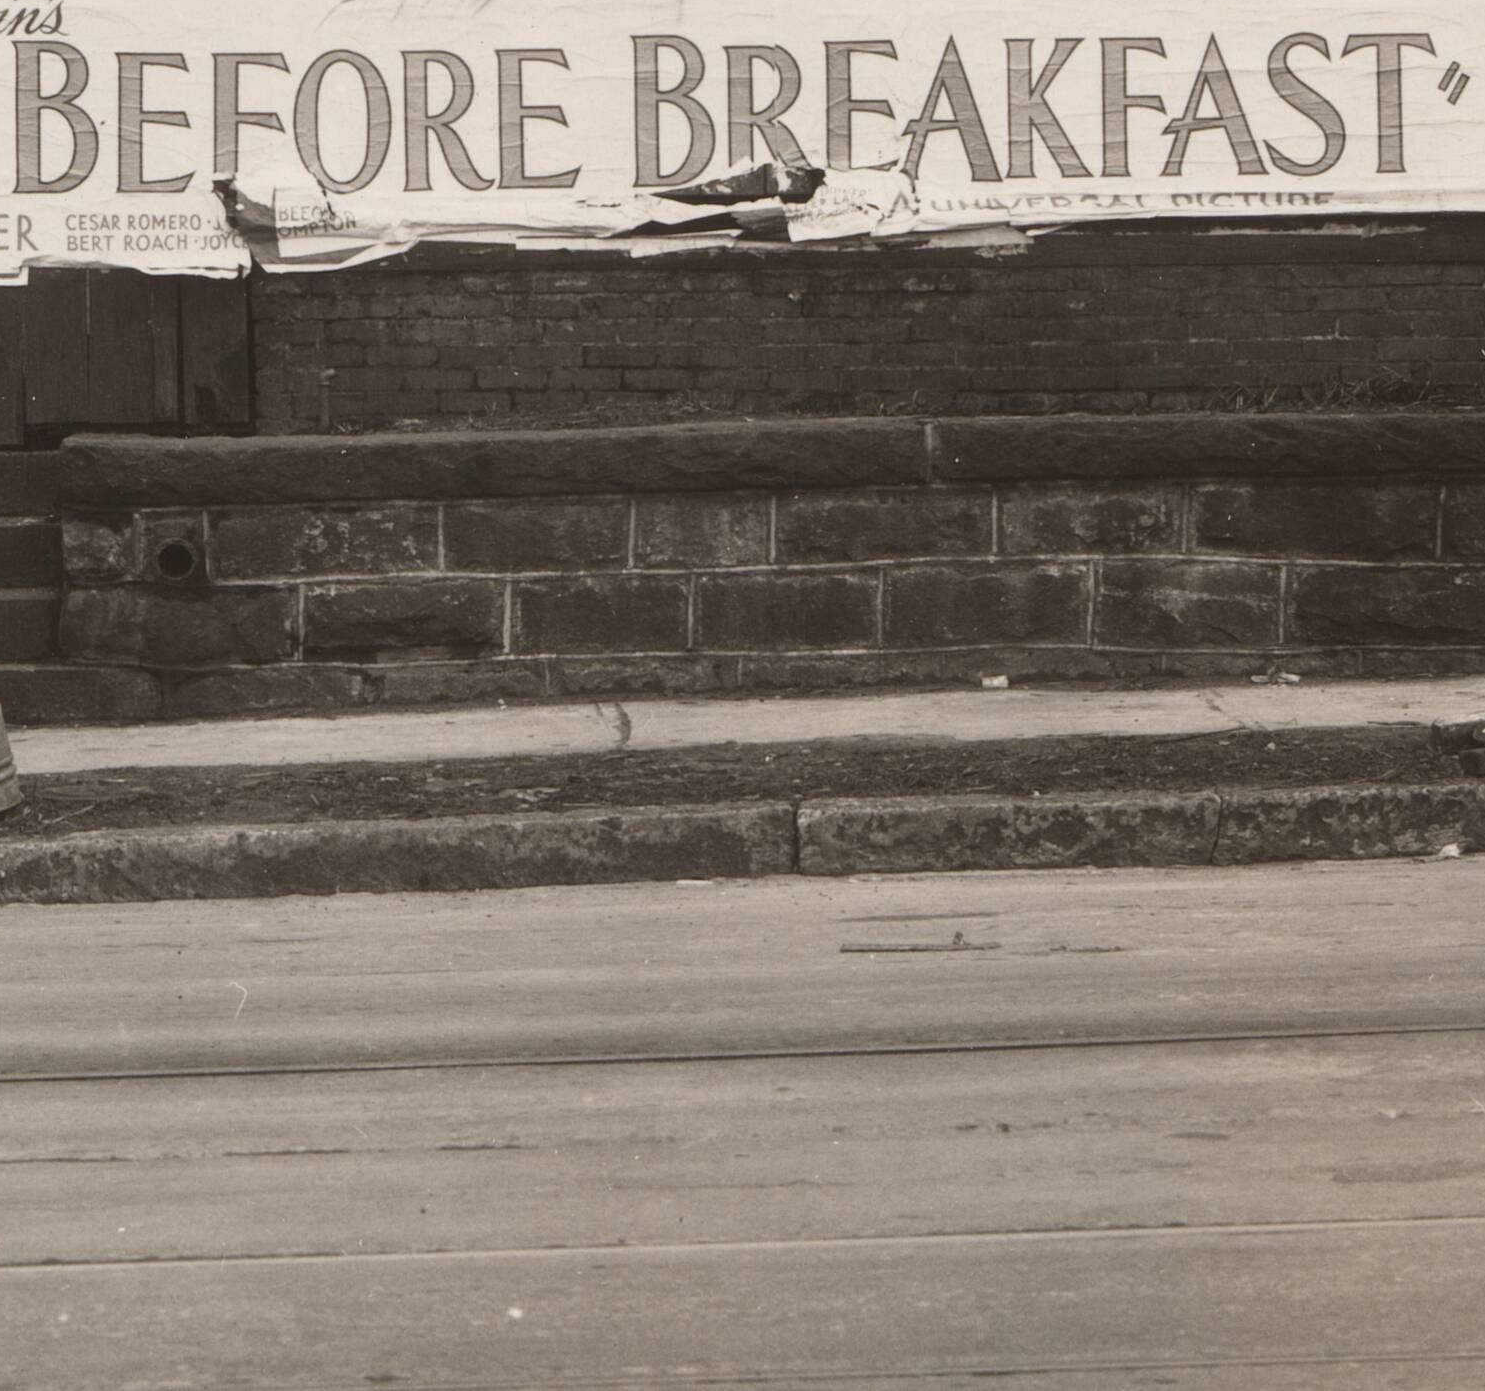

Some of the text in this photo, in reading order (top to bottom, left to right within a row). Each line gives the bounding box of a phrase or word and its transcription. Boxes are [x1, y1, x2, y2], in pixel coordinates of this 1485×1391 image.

[12, 40, 582, 197] BEFORE
[65, 214, 121, 231] CESAR
[128, 213, 202, 231] ROMERO
[67, 235, 114, 251] BERT
[124, 234, 187, 251] ROACH
